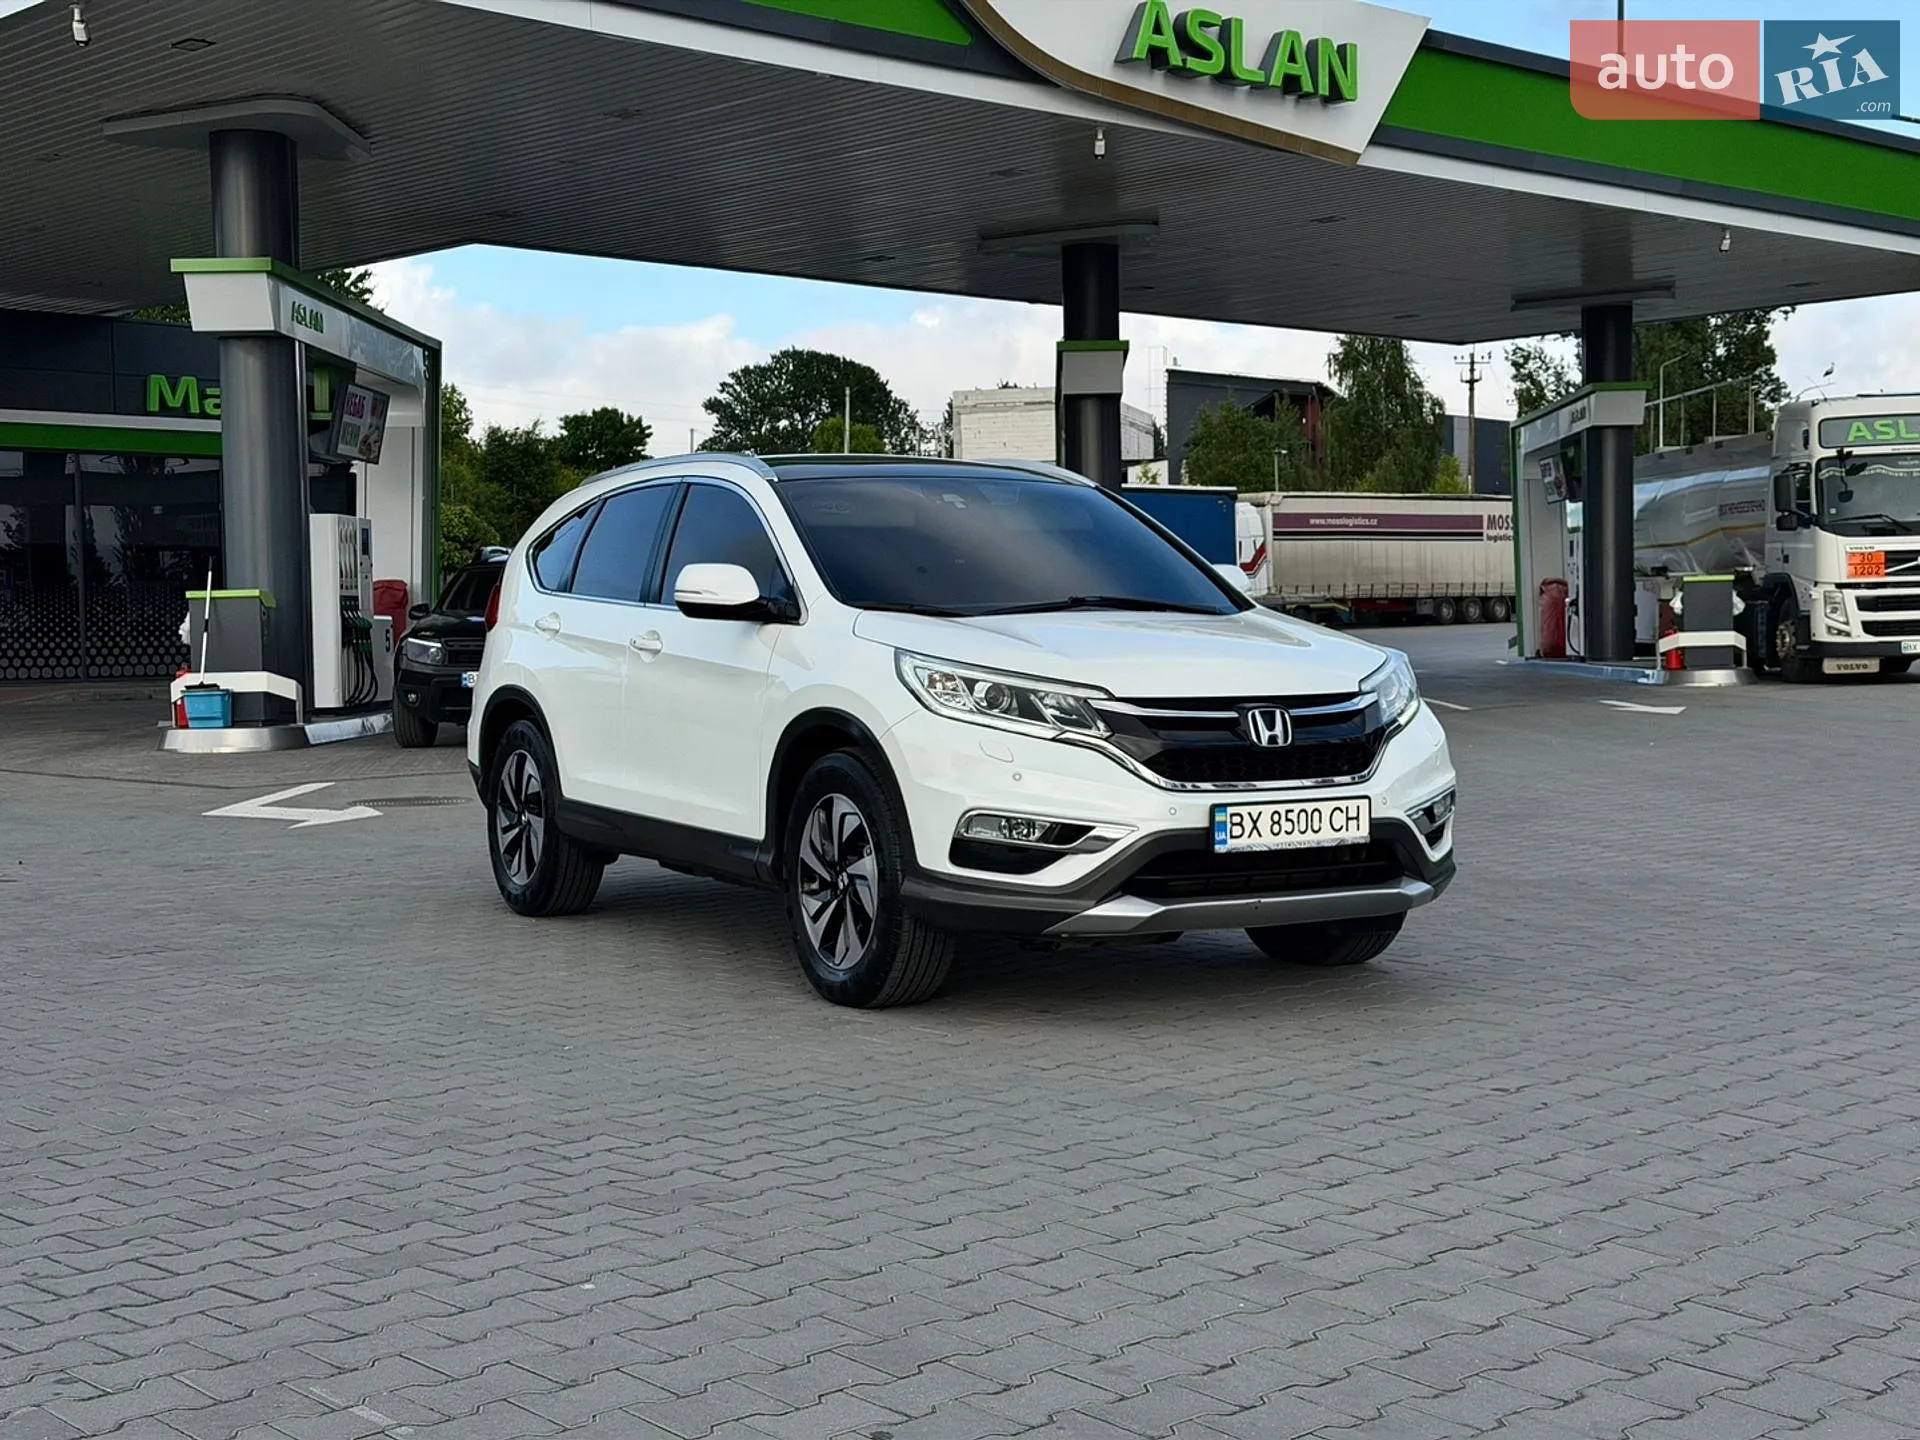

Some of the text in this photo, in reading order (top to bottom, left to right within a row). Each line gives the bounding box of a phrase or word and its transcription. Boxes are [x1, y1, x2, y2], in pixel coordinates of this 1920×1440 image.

[1116, 0, 1358, 102] ASLAN
[1853, 565, 1881, 576] 1202
[1229, 805, 1361, 839] BX 8500 CH
